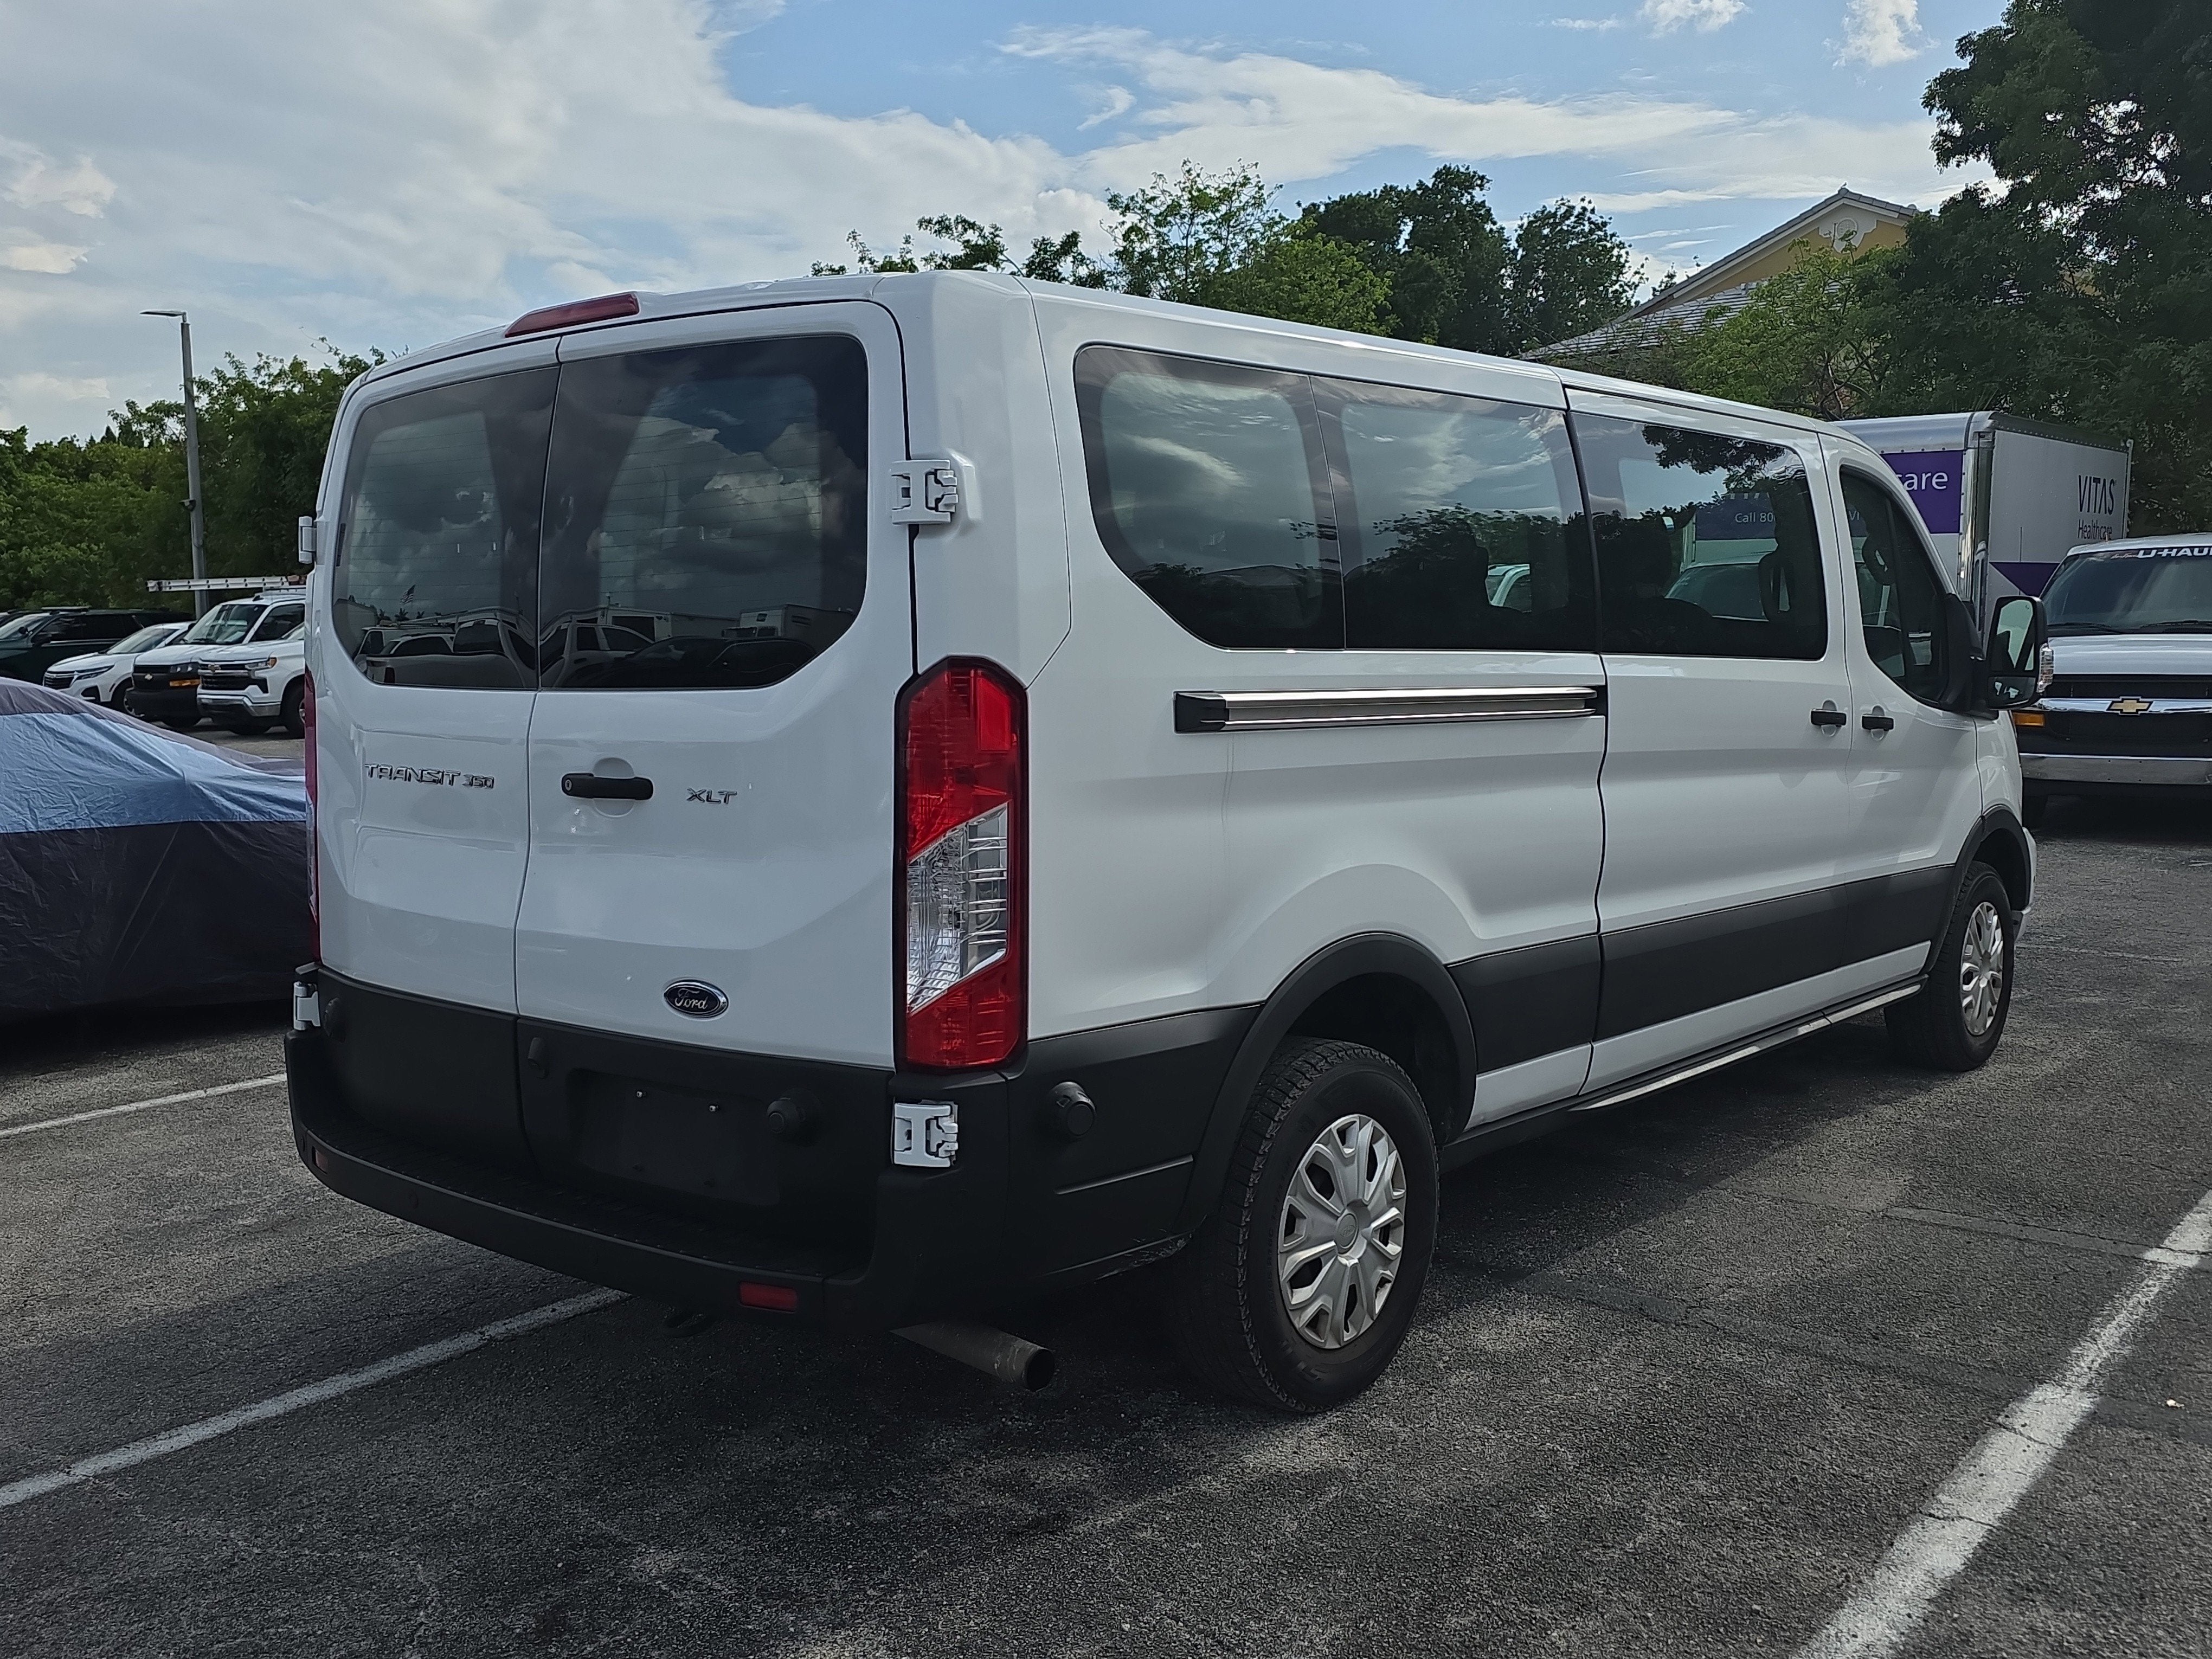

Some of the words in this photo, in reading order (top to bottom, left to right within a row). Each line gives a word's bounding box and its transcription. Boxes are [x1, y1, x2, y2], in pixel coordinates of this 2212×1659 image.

[2078, 474, 2115, 516] VITAS
[1735, 512, 1756, 523] Call
[1759, 512, 1776, 523] 80
[2077, 519, 2113, 541] Healthcare
[364, 763, 461, 786] TRANSIT
[686, 787, 738, 805] XLT
[674, 987, 709, 1009] Ford
